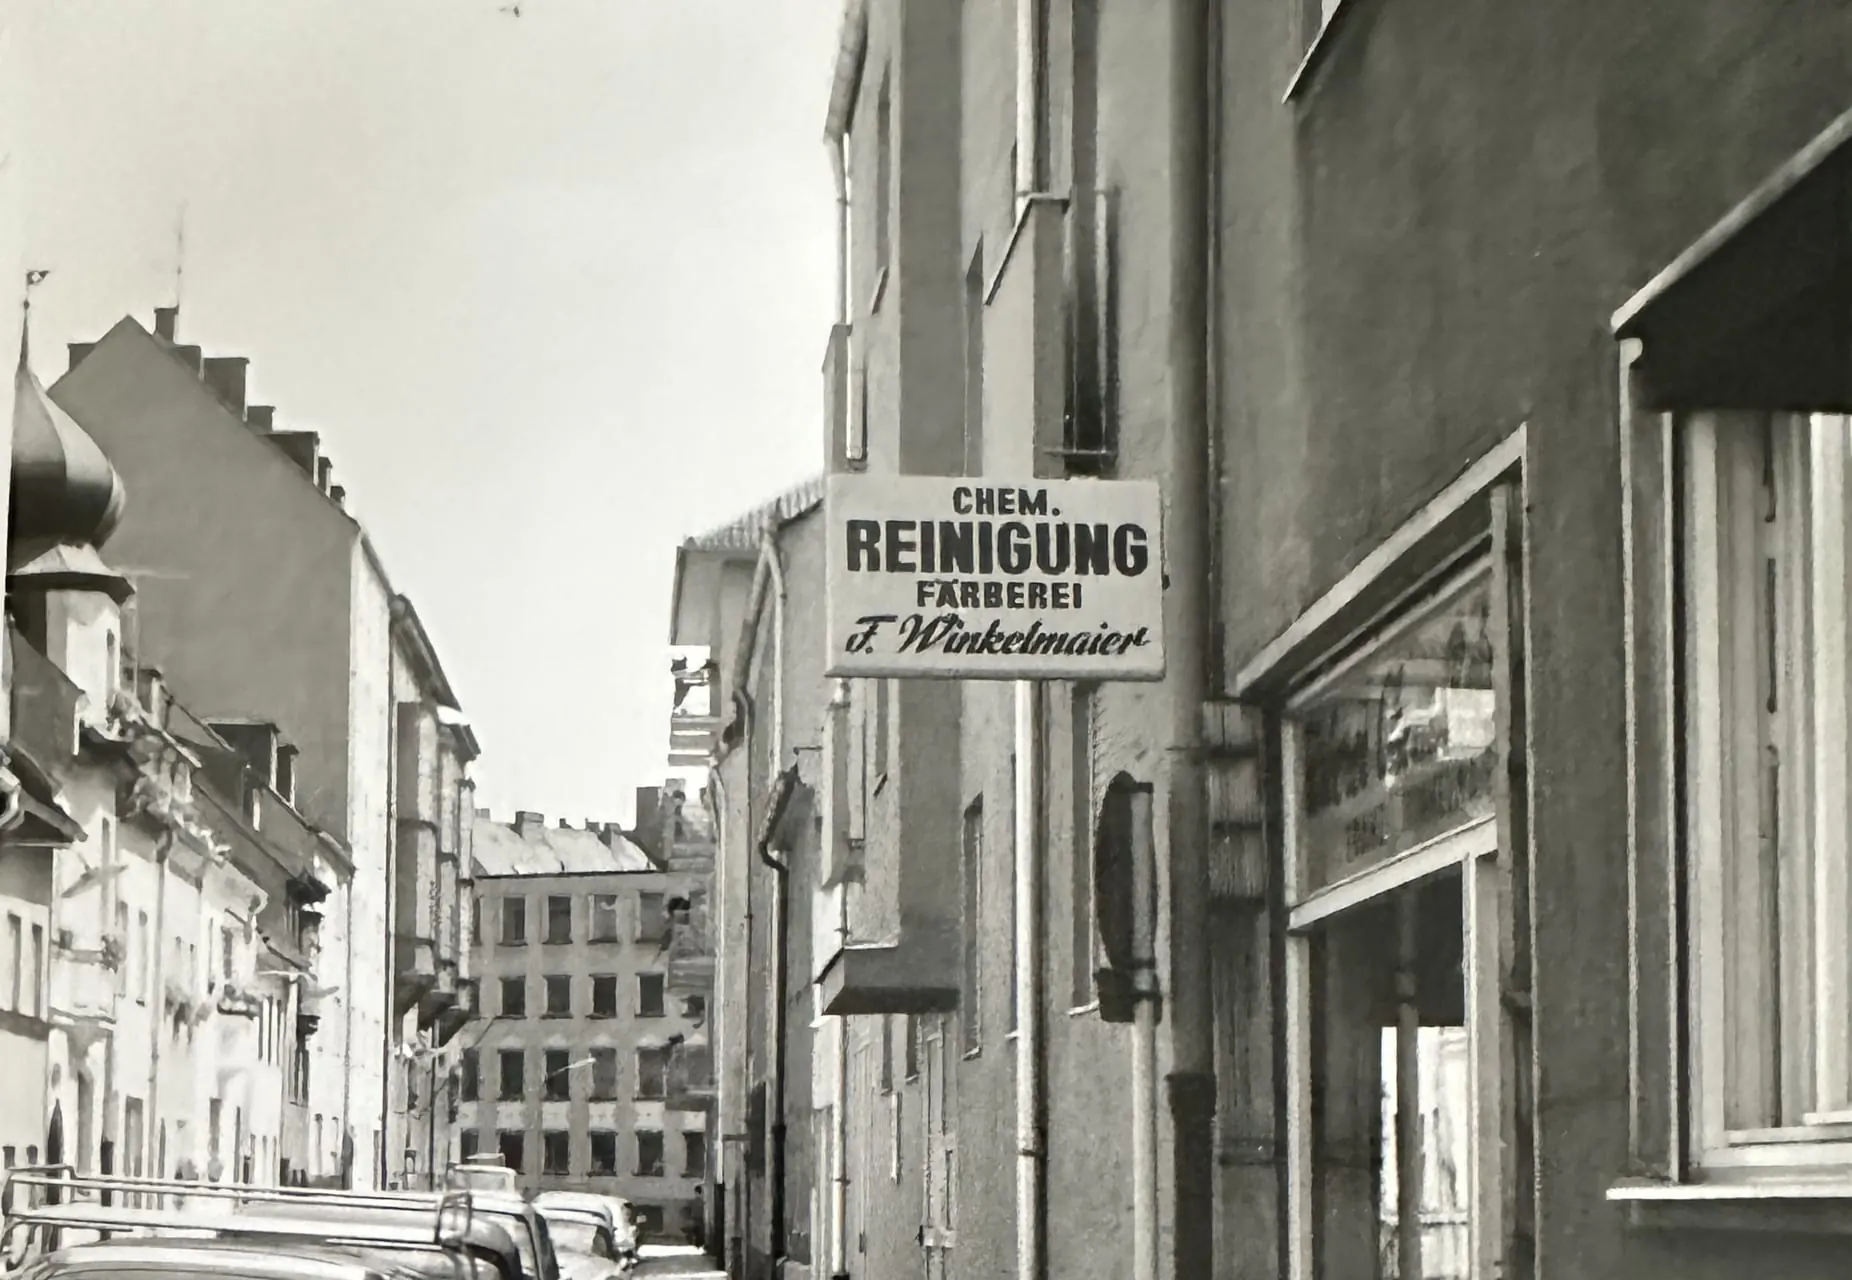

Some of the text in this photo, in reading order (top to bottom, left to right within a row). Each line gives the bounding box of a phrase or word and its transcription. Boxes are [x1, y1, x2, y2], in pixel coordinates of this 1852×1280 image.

[952, 486, 1061, 517] CHEM.
[846, 519, 1149, 577] REINIGUNG
[916, 578, 1083, 610] FÄRBEREI
[897, 612, 1150, 656] Winkelmaier
